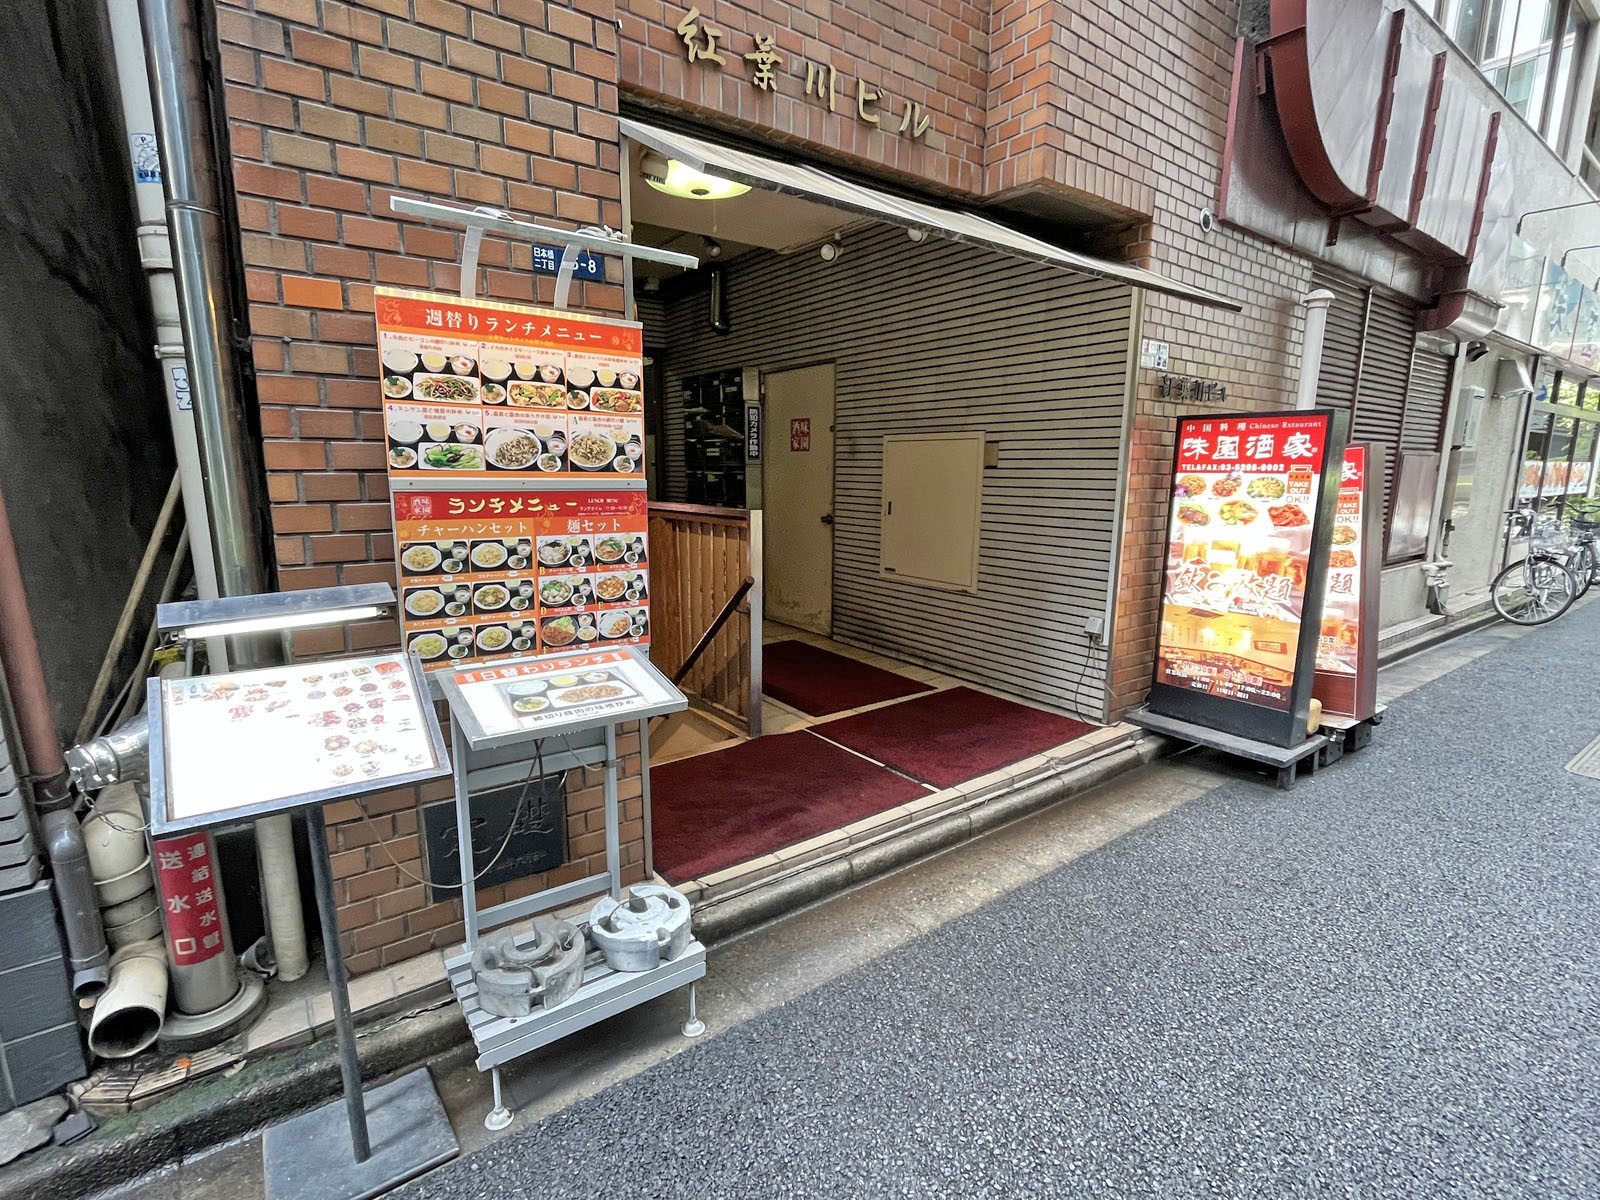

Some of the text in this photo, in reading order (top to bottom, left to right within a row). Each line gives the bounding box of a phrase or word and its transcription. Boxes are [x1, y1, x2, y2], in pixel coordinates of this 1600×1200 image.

[676, 7, 930, 138] 紅葉川ビル
[533, 247, 555, 260] 日本橋
[534, 259, 555, 270] 二丁目
[425, 308, 603, 341] 週替りランチメニュー
[1186, 422, 1246, 433] 中国料理
[1249, 422, 1279, 430] Chinese
[1183, 431, 1313, 460] 味園酒家
[448, 497, 577, 514] ランチメニュー
[417, 521, 527, 537] チャーハンセット
[567, 518, 621, 534] 麺セット
[540, 567, 546, 576] B
[480, 656, 608, 681] 日替わりランチ
[158, 850, 198, 955] 送水口
[187, 842, 220, 949] 連結送水管
